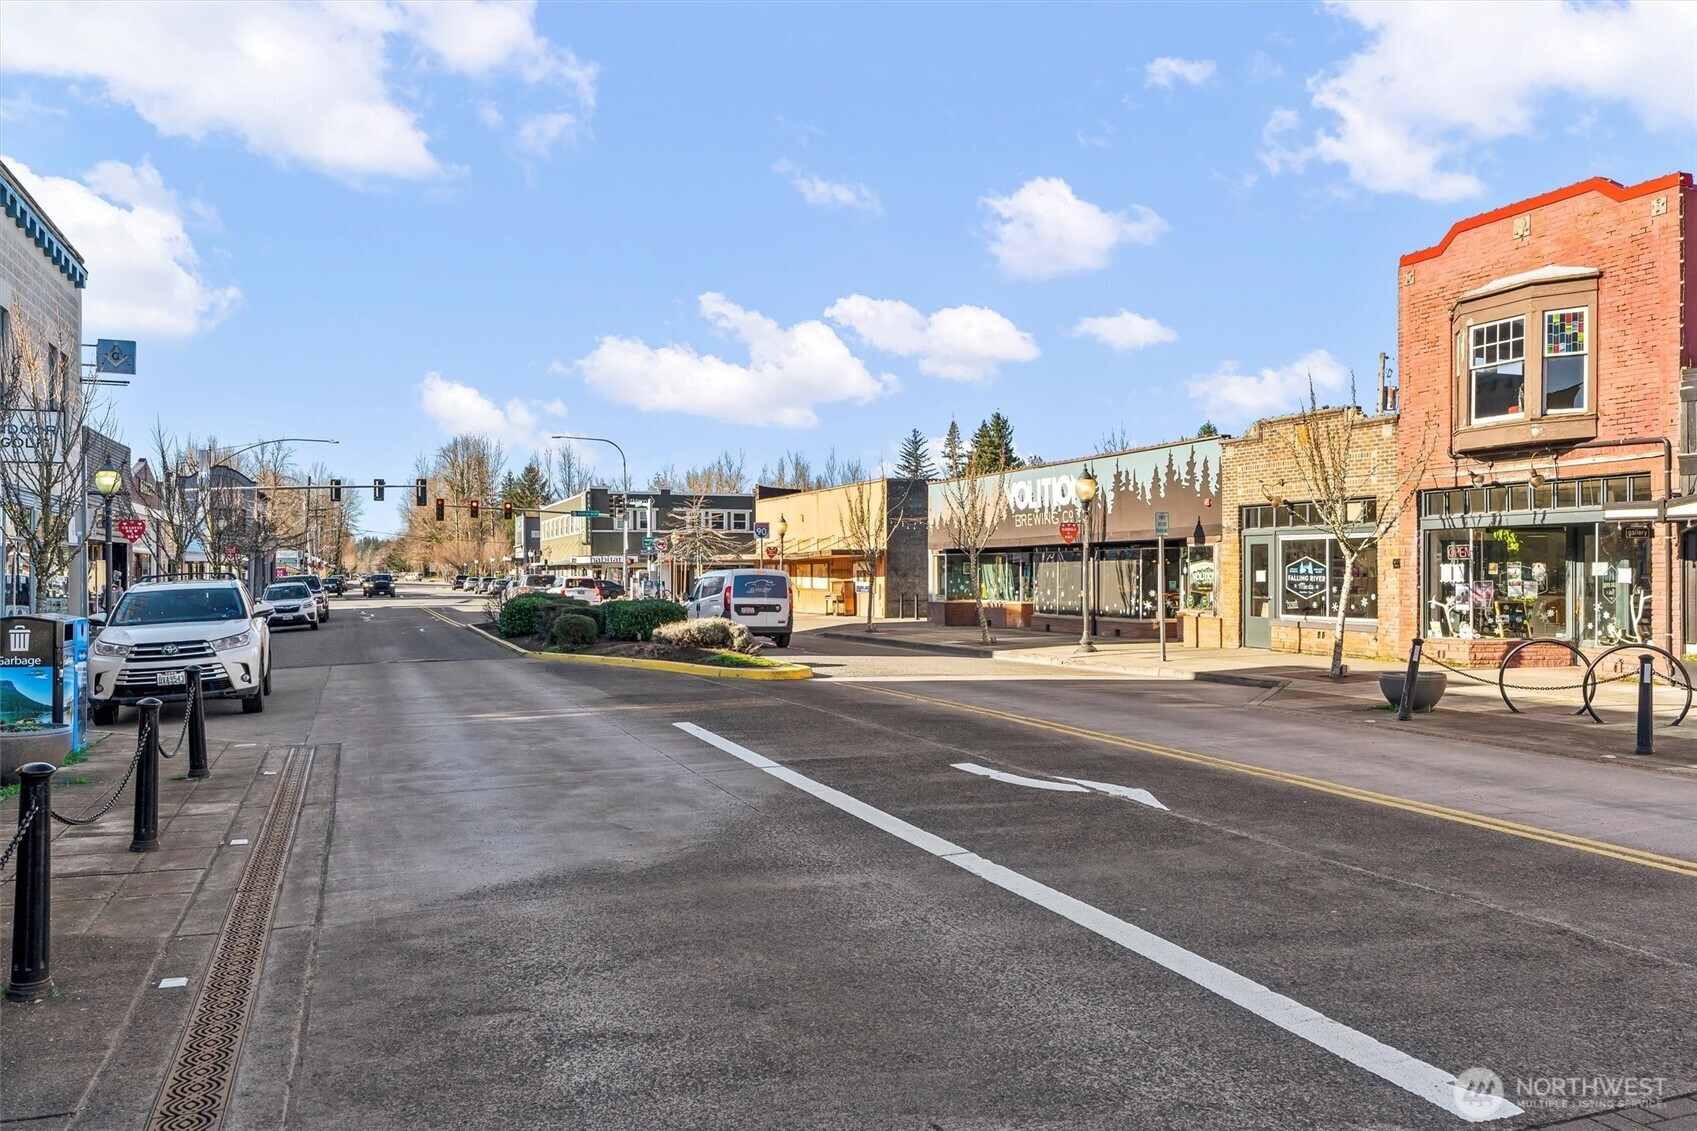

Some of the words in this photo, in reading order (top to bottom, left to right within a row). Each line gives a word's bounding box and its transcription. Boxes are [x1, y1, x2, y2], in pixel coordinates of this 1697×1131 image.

[1014, 512, 1060, 527] BREWING
[756, 527, 767, 536] 90
[1627, 530, 1648, 538] gallery
[0, 656, 41, 667] Garbage
